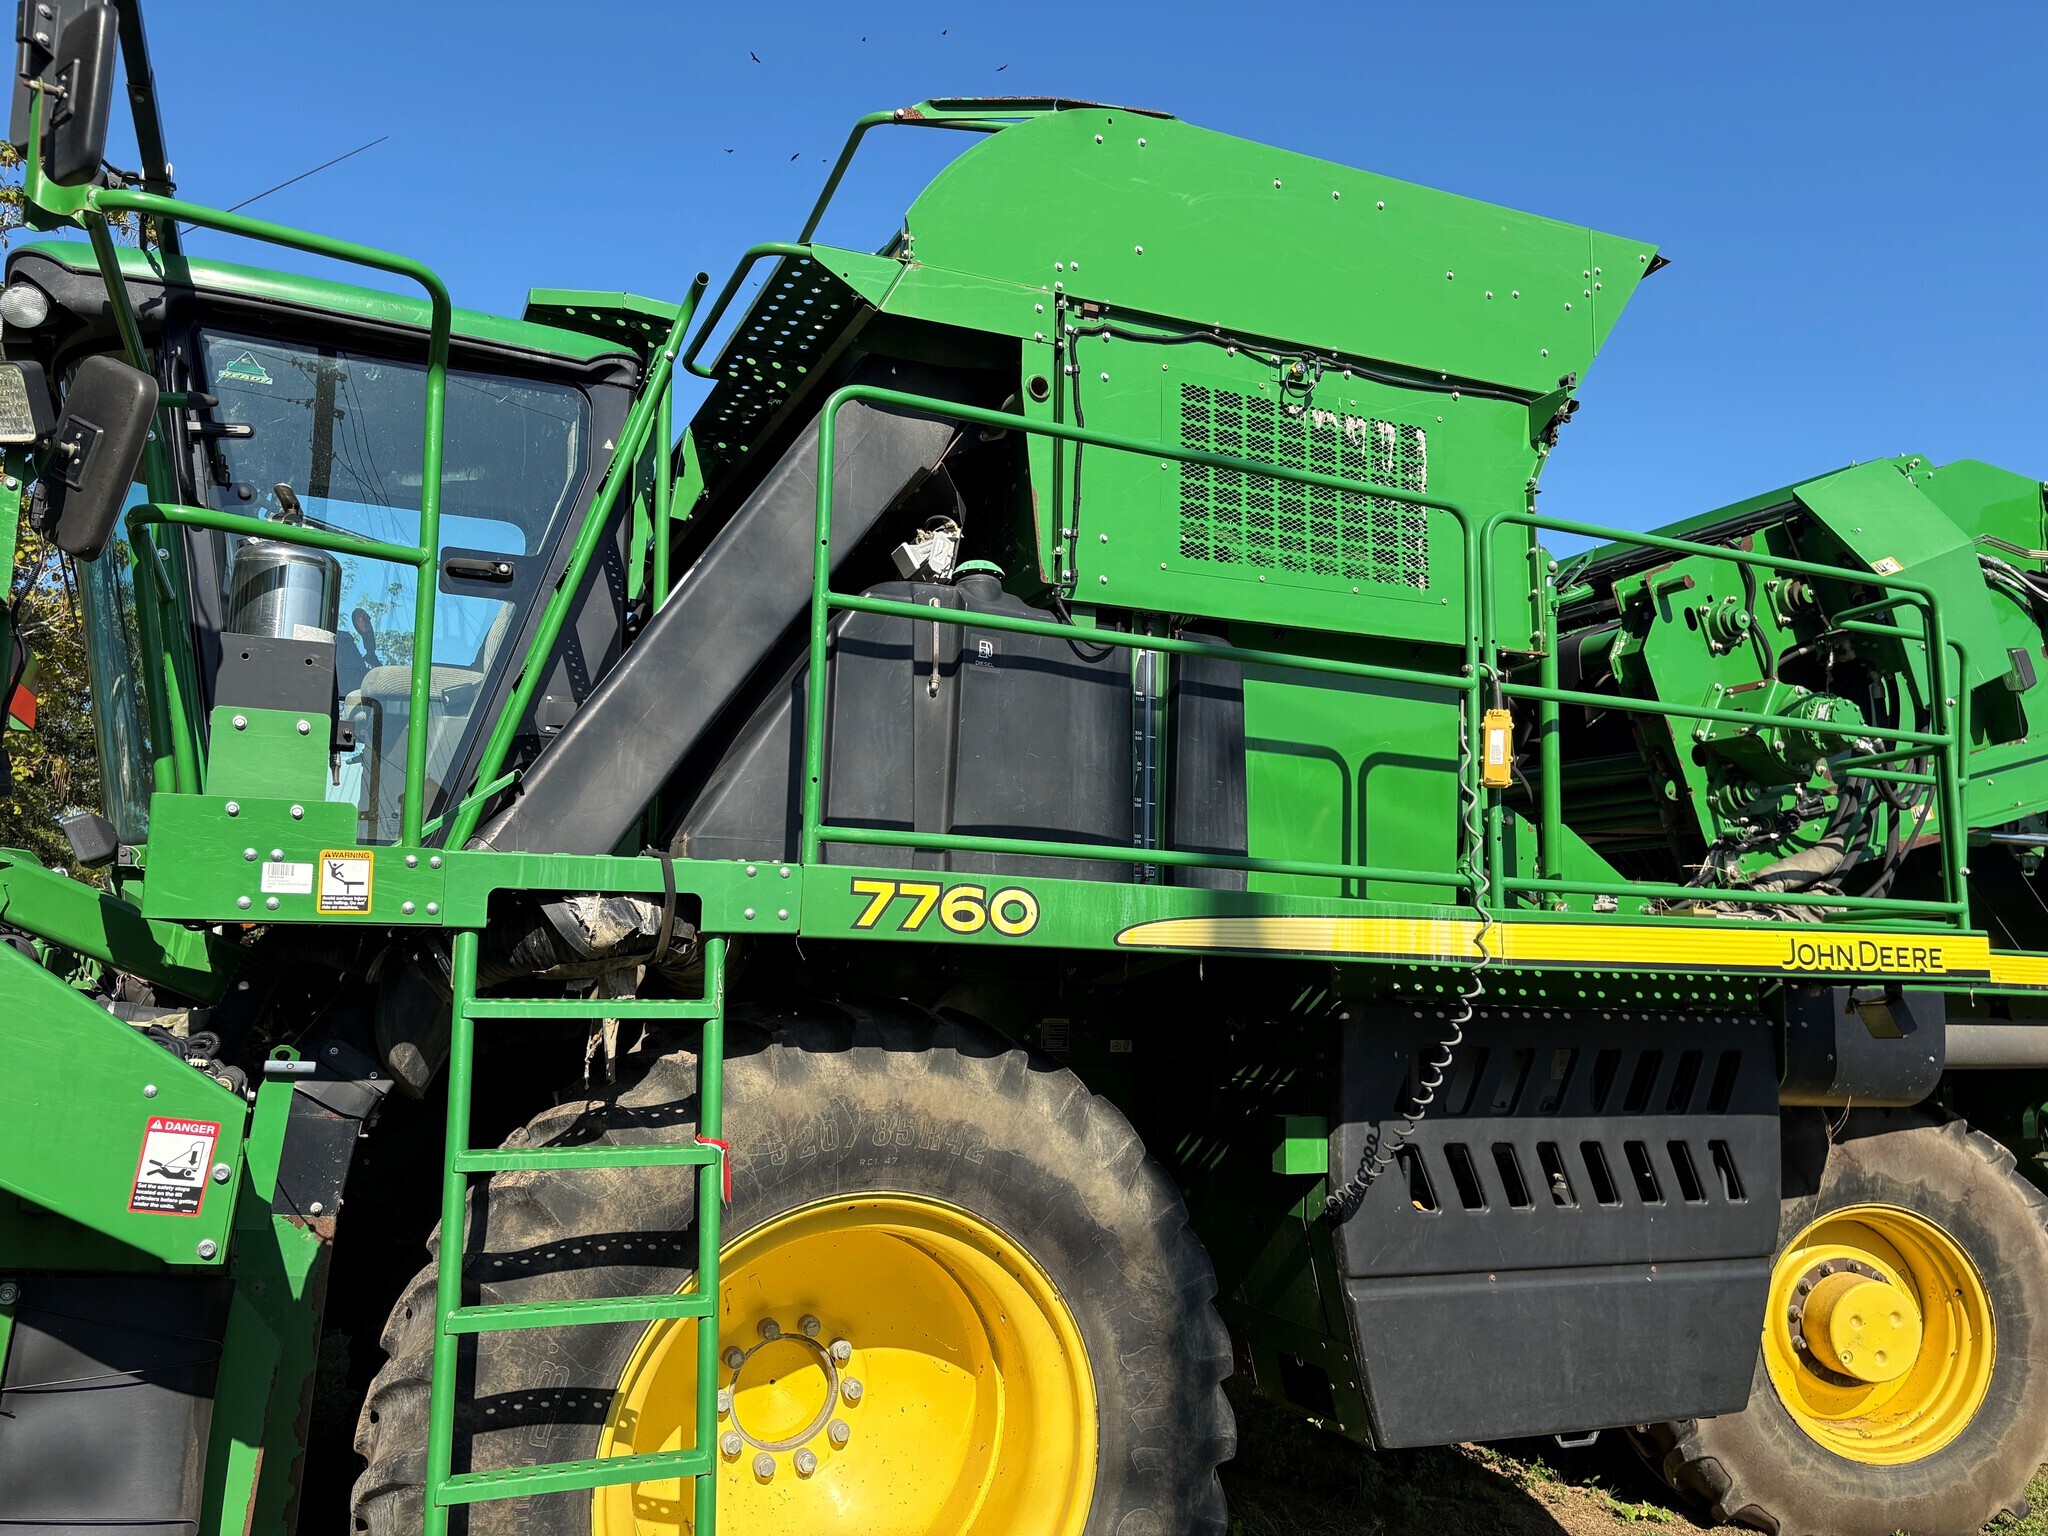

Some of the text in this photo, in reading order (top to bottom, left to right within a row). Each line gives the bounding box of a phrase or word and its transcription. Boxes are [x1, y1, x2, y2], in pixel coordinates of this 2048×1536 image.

[975, 660, 995, 668] DIESEL
[851, 877, 1041, 937] 7760
[1782, 938, 1943, 968] JOHN DEERE
[165, 1121, 215, 1134] DANGER
